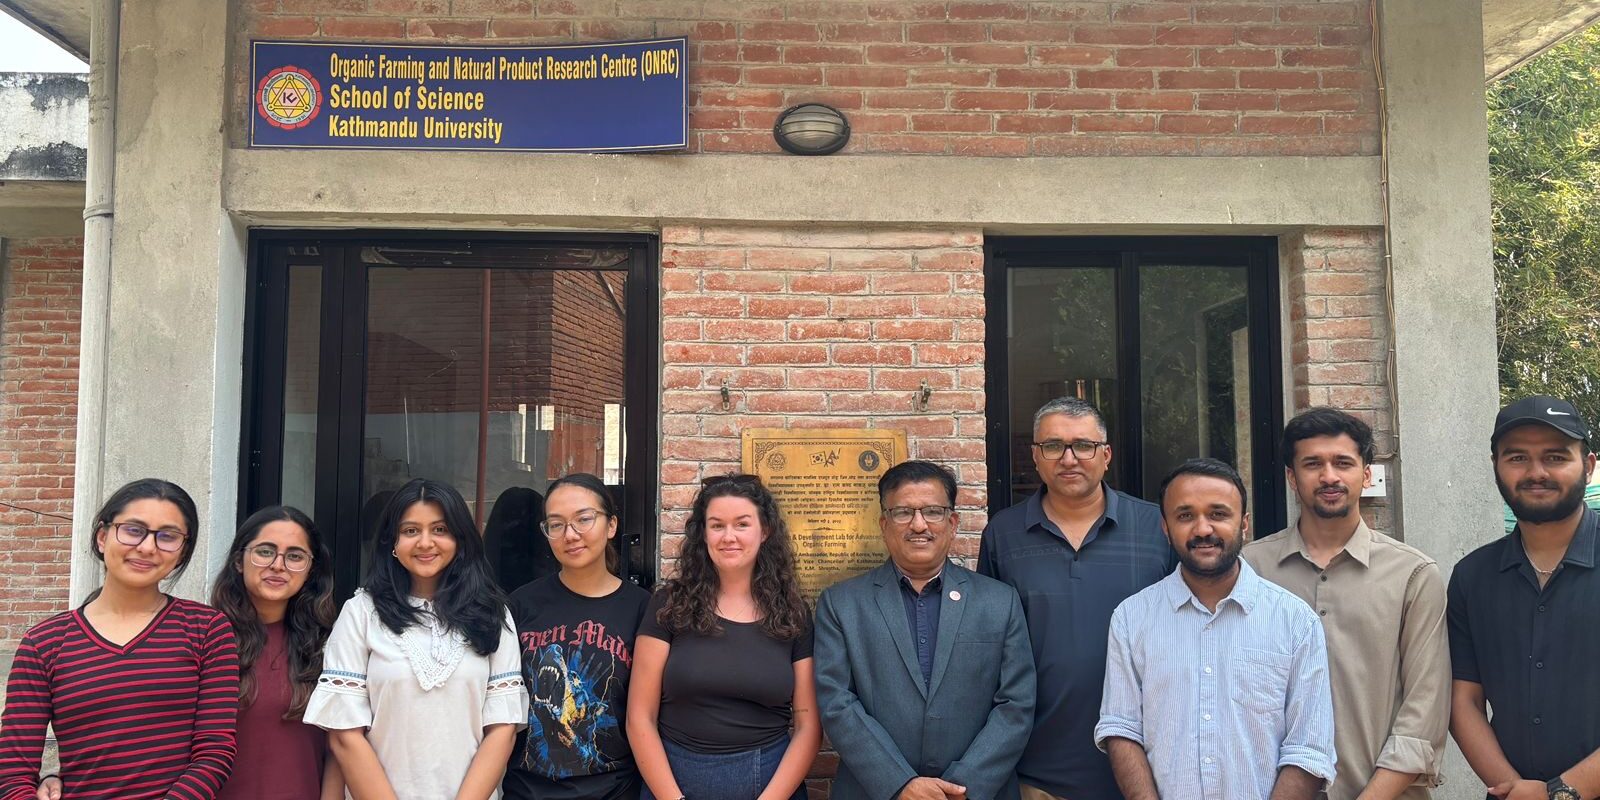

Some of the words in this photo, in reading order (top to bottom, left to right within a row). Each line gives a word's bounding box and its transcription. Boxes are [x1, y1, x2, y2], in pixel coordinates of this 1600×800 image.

[330, 52, 375, 83] Organic
[378, 54, 425, 85] Farming
[428, 56, 450, 80] and
[453, 56, 496, 80] Natural
[499, 56, 543, 80] Product
[546, 55, 597, 80] Research
[601, 53, 637, 79] Centre
[641, 48, 680, 82] (ONRC)
[330, 84, 388, 109] School
[394, 85, 411, 109] of
[417, 85, 484, 110] Science
[329, 115, 418, 138] Kathmandu
[424, 116, 503, 144] University
[798, 534, 835, 542] Development
